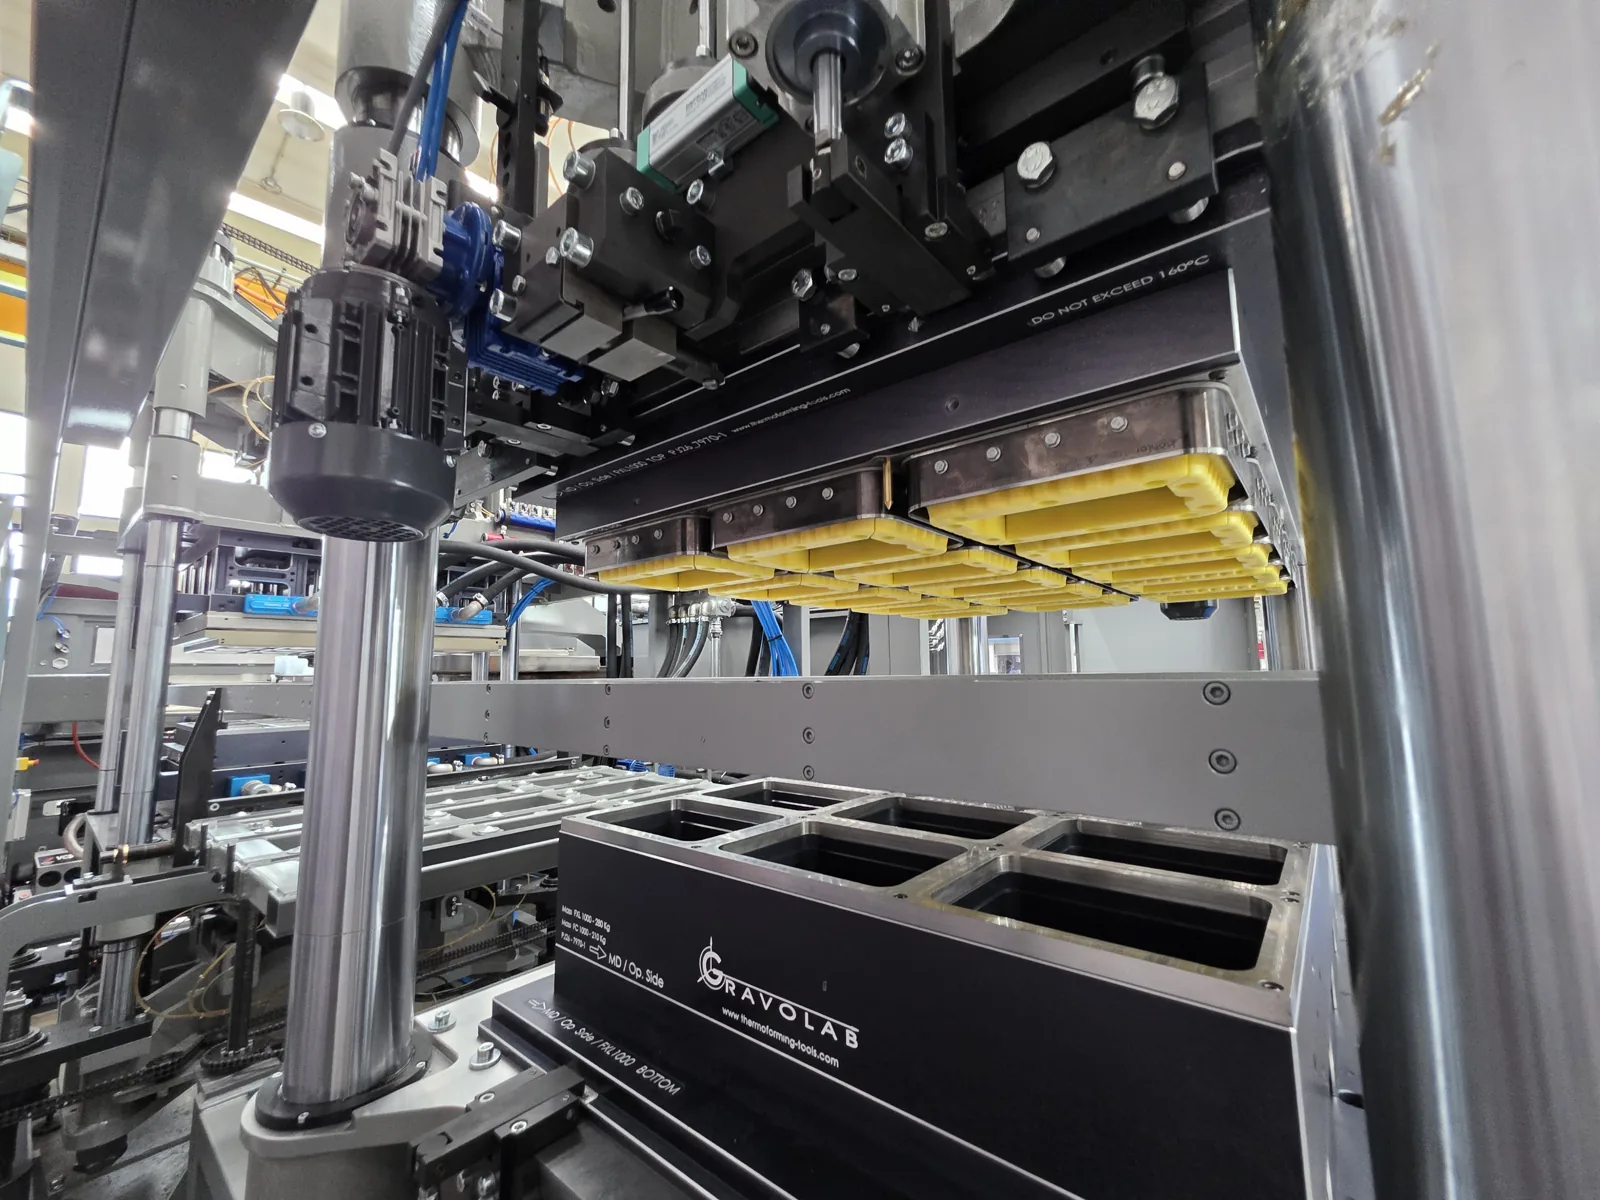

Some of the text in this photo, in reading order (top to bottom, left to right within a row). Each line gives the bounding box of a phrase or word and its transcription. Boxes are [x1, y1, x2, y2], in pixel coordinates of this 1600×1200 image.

[1030, 311, 1055, 325] DO
[1057, 299, 1089, 315] NOT
[1091, 275, 1154, 303] EXCEED
[645, 453, 666, 463] TOP
[599, 934, 607, 946] Kg
[603, 920, 611, 933] Kg
[608, 952, 622, 968] MD
[628, 961, 644, 980] Op.
[646, 968, 665, 989] Side
[699, 946, 859, 1049] GRAVOLAB
[545, 1007, 560, 1020] MD
[574, 1027, 595, 1042] Side
[635, 1064, 682, 1096] BOTTOM
